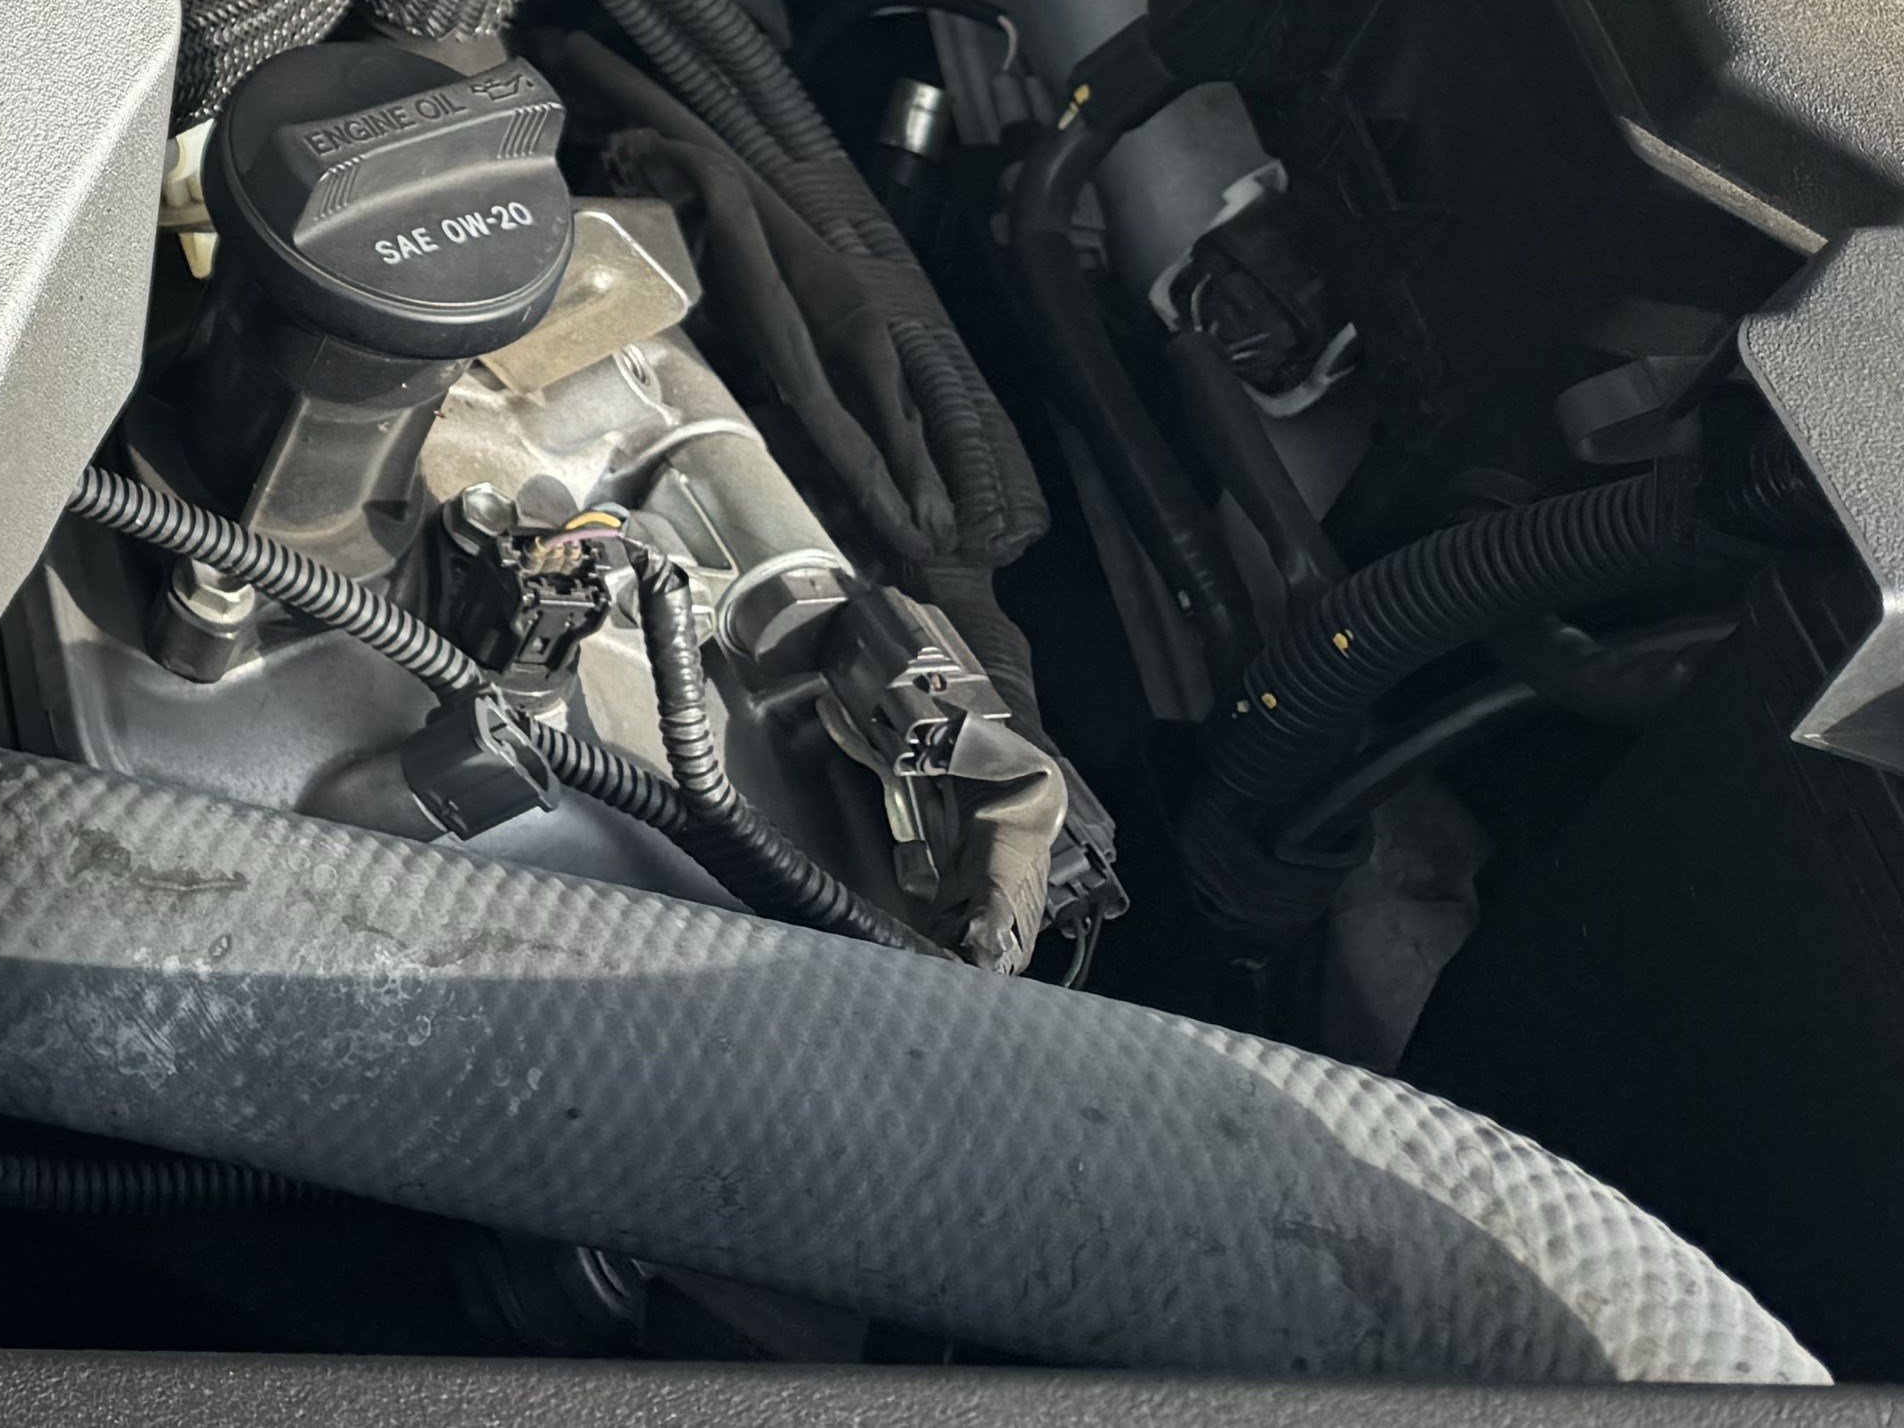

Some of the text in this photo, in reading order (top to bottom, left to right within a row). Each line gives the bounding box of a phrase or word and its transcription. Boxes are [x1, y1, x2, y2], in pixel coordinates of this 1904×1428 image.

[304, 92, 467, 156] ENGINE OIL
[374, 201, 534, 265] SAE 0W-20
